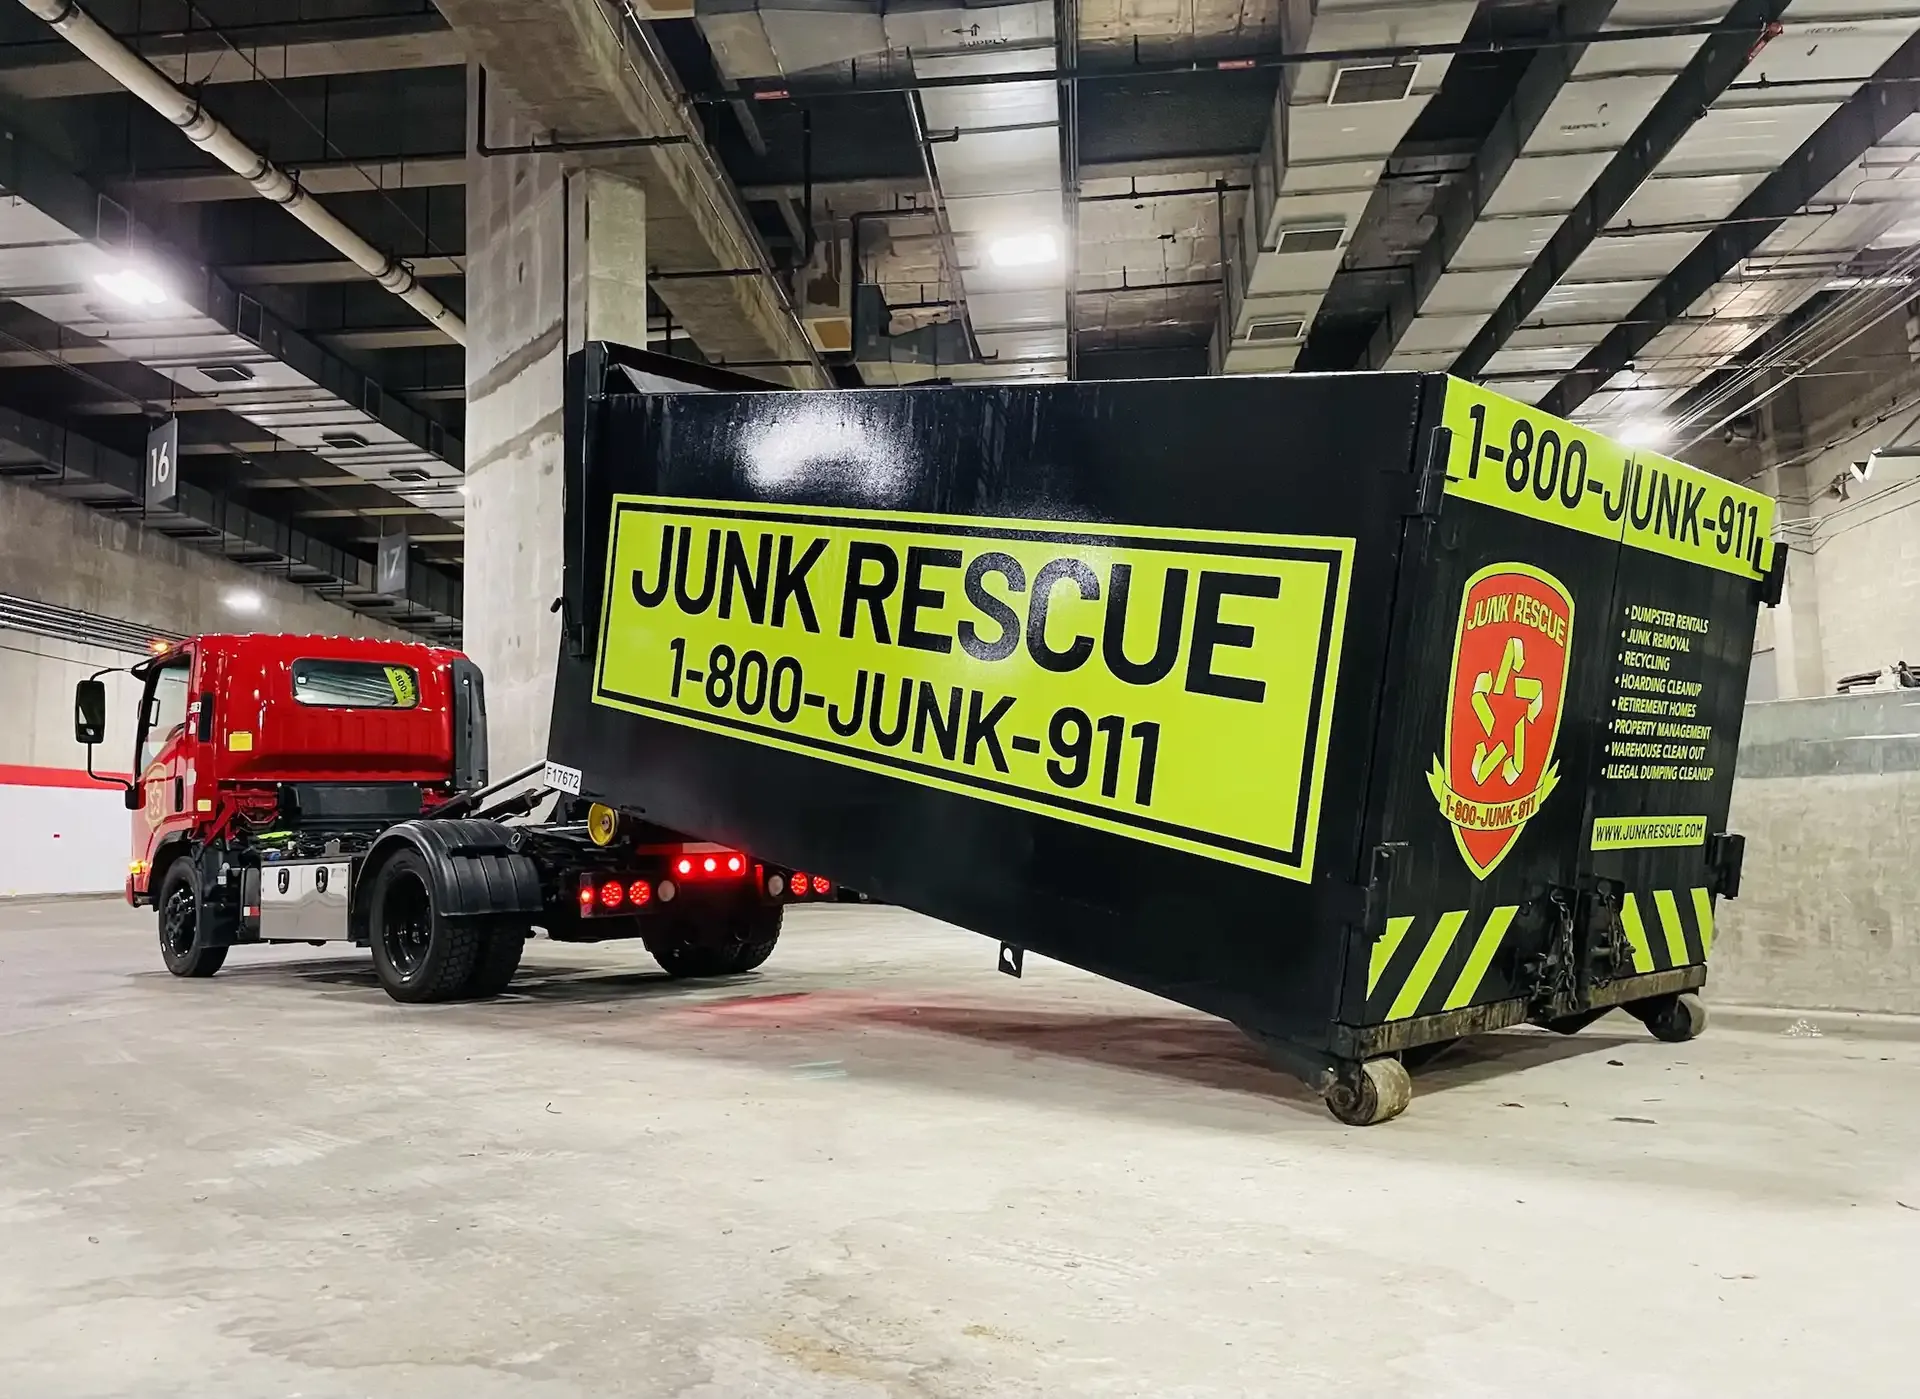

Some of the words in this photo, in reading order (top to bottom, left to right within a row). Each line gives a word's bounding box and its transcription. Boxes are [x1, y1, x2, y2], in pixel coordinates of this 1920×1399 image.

[151, 441, 170, 487] 16
[1468, 404, 1759, 562] 1-800-JUNK-911
[383, 545, 402, 580] 17
[631, 524, 830, 634] JUNK
[839, 541, 1281, 704] RESCUE
[1467, 592, 1513, 630] JUNK
[1513, 592, 1566, 647] RESCUE
[1630, 605, 1675, 628] DUMPSTER
[1676, 613, 1709, 634] RENTALS
[1627, 628, 1652, 647] JUNK
[1652, 632, 1691, 653] REMOVAL
[1624, 651, 1671, 672] RECYCLING
[1620, 673, 1666, 693] HOARDING
[1667, 679, 1702, 697] CLEANUP
[1617, 696, 1668, 715] RETIREMENT
[1669, 701, 1697, 718] HOMES
[669, 637, 1161, 807] 1-800-JUNK-911
[1614, 718, 1656, 737] PROPERTY
[1656, 722, 1711, 740] MANAGEMENT
[1611, 741, 1662, 759] WAREHOUSE
[1662, 744, 1688, 760] CLEAN
[1688, 746, 1705, 761] OUT
[546, 766, 580, 789] F17672
[1606, 763, 1639, 779] ILLEGAL
[1640, 764, 1678, 780] DUMPING
[1679, 766, 1714, 781] CLEANUP
[1446, 794, 1537, 828] 1-800-JUNK-911
[1596, 823, 1703, 842] WWW.JUNKRESCUE.COM
